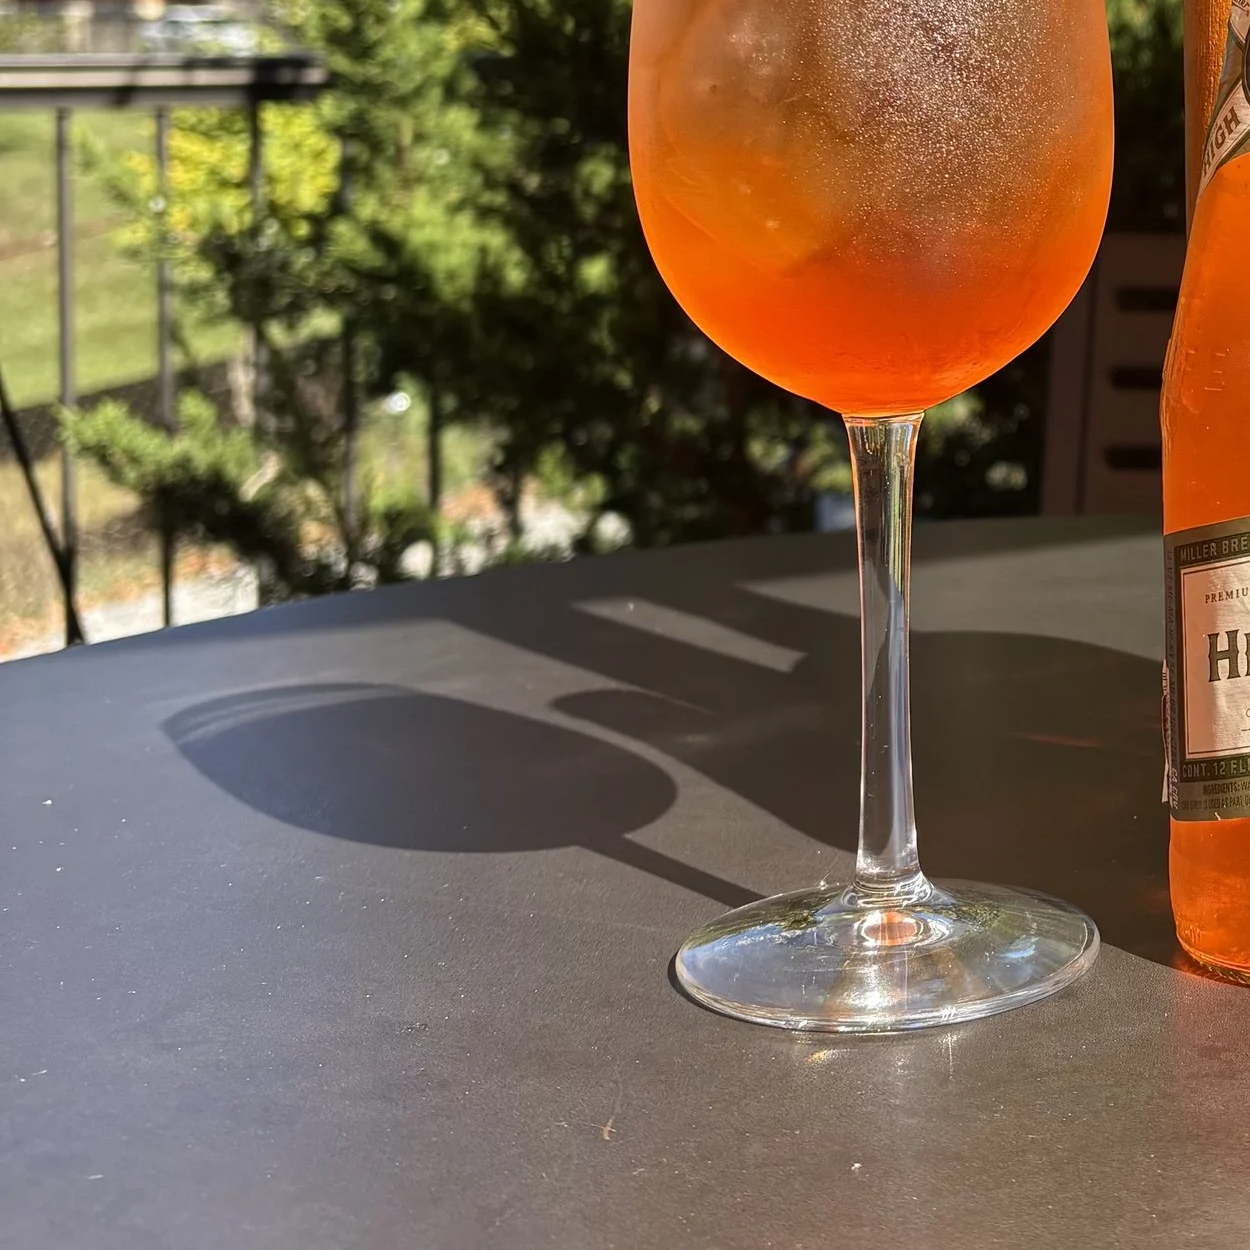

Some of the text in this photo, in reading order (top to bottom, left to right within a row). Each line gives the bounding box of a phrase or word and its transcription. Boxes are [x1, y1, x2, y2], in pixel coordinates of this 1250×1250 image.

[1203, 106, 1241, 176] HIGH
[1180, 542, 1218, 562] MILLER
[1214, 761, 1226, 775] 12
